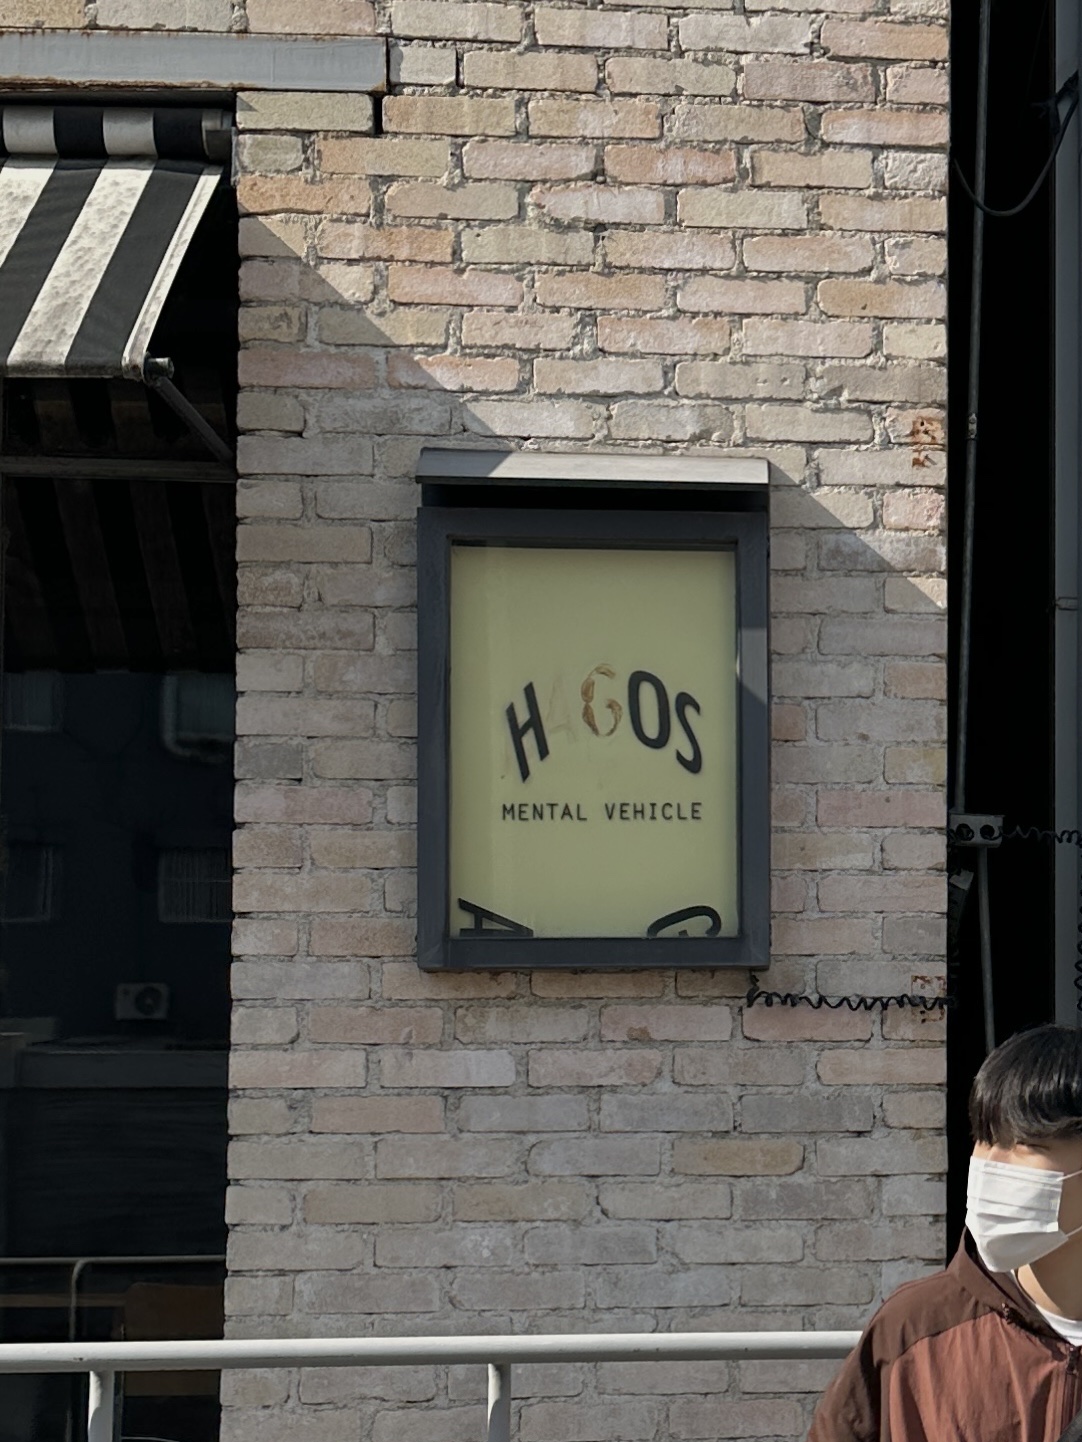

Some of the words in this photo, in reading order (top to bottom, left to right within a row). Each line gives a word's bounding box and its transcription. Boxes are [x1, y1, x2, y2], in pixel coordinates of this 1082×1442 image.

[505, 663, 703, 784] HGOS
[502, 803, 588, 821] MENTAL
[605, 802, 702, 821] VEHICLE
